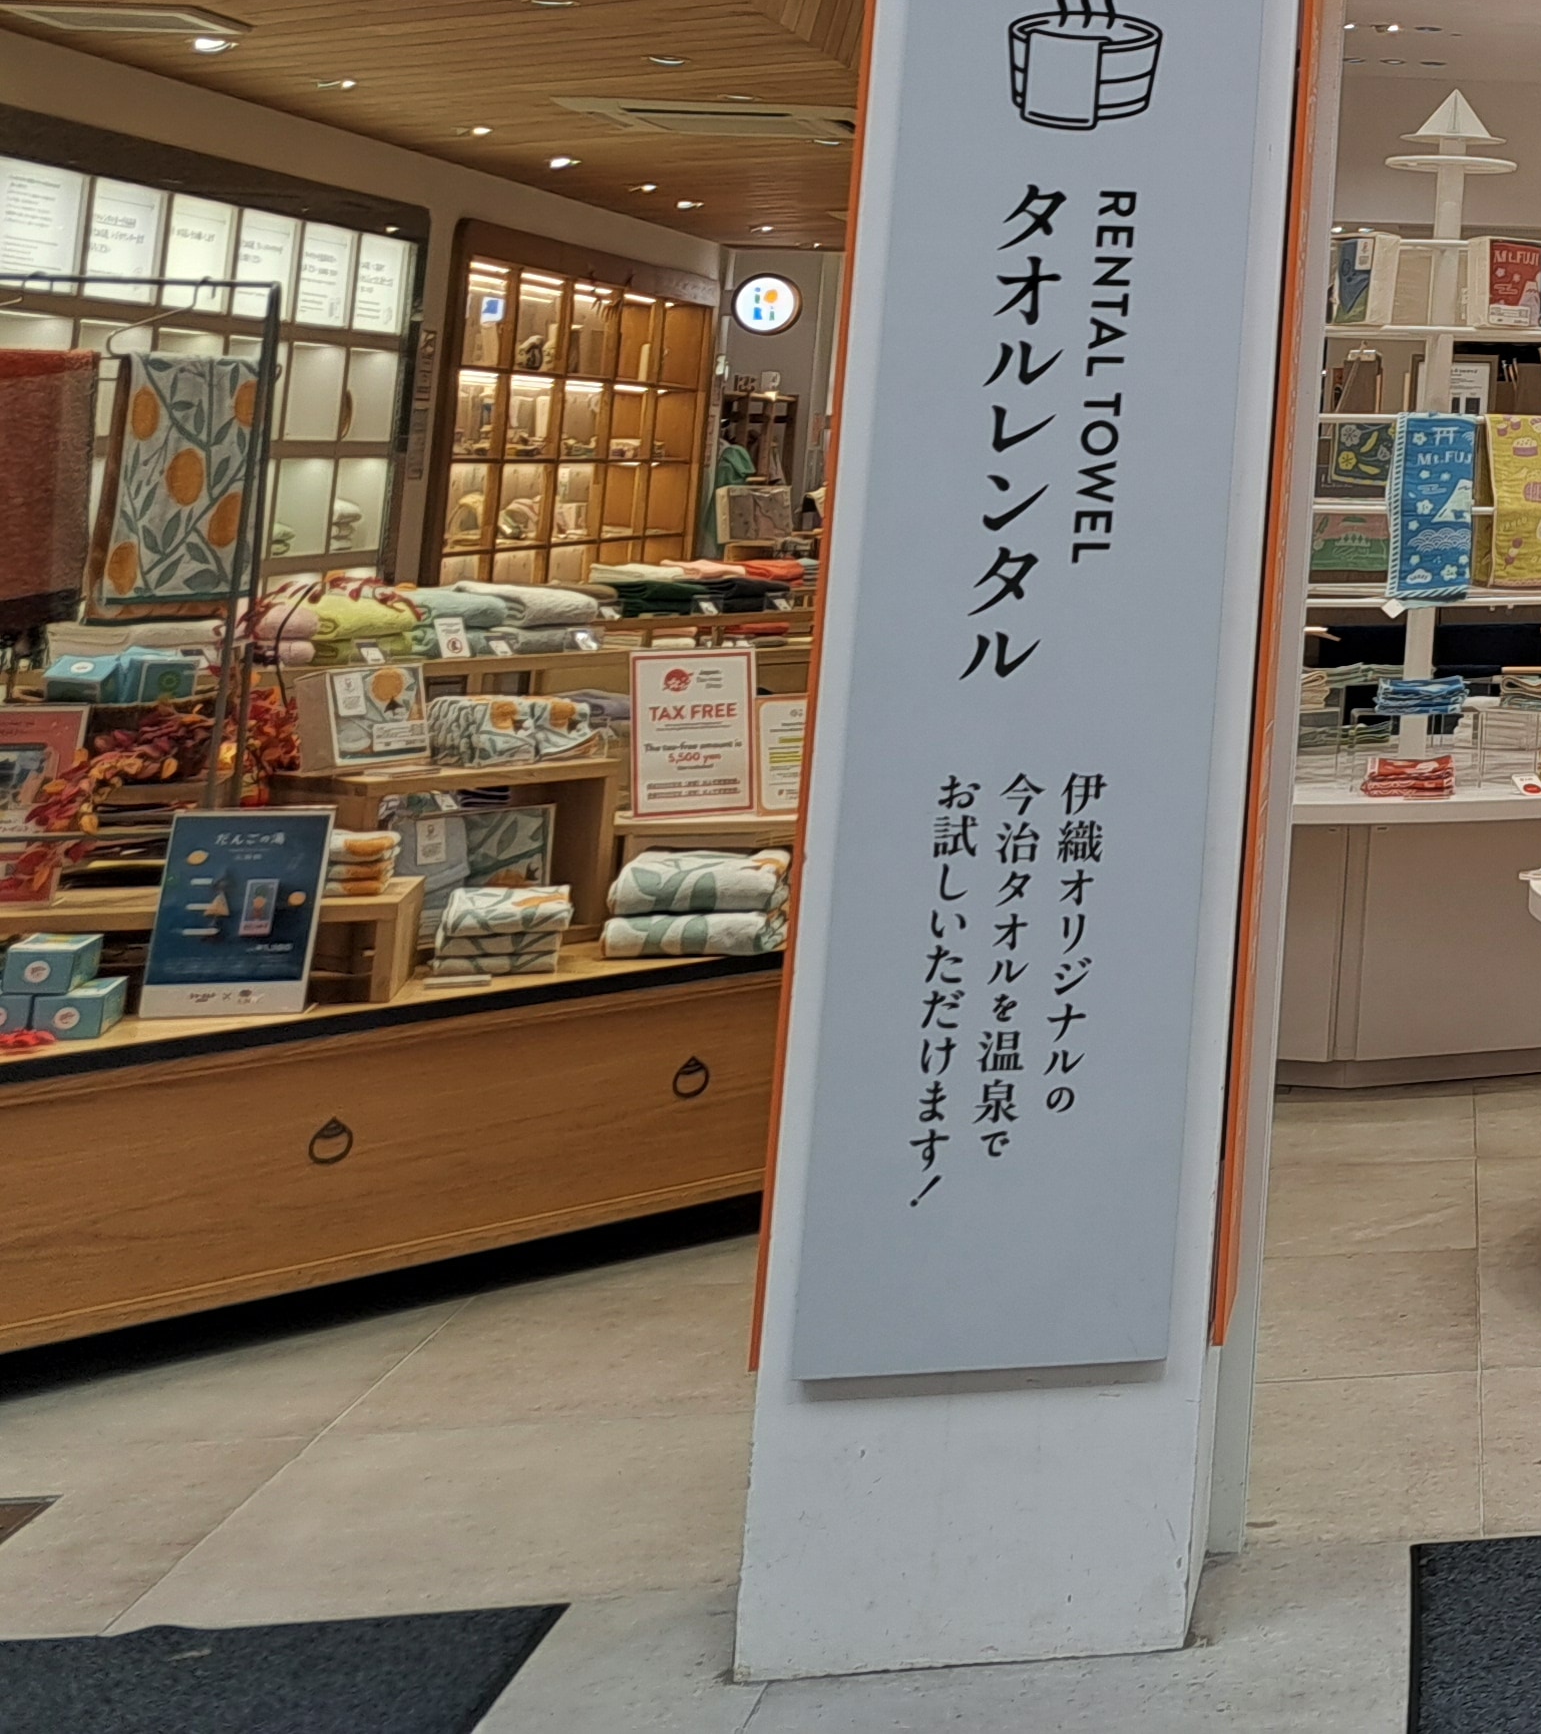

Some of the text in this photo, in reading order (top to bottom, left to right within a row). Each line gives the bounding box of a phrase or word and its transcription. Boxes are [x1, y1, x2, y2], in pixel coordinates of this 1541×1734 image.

[959, 184, 1067, 681] タオルレンタル
[1071, 190, 1138, 565] RENTAL TOWEL
[649, 702, 738, 722] TAX FREE
[909, 774, 981, 1208] お試しいただけます！
[973, 772, 1046, 1158] 今治タオルを温泉で
[1044, 771, 1107, 1115] 伊織オリジナルの
